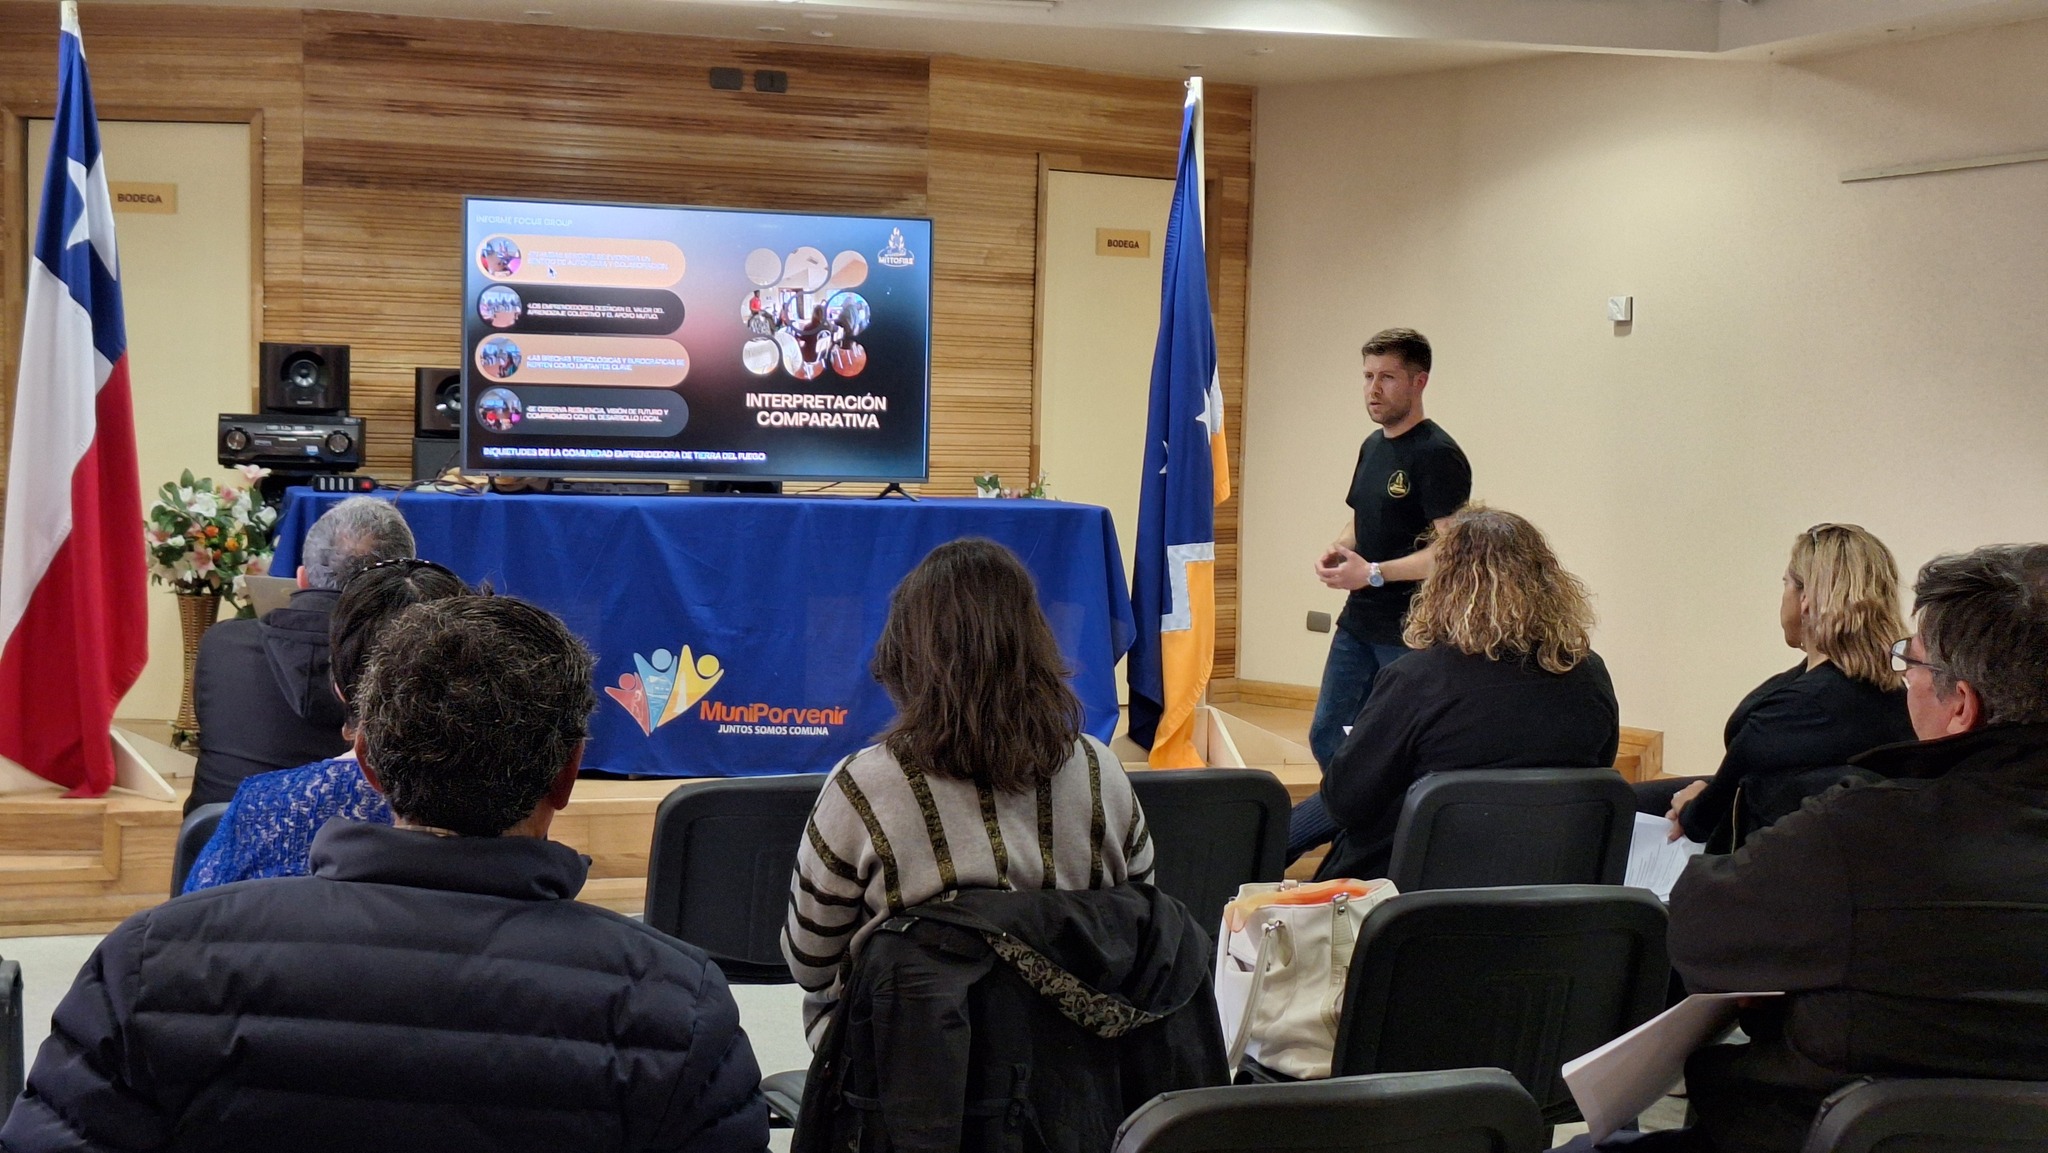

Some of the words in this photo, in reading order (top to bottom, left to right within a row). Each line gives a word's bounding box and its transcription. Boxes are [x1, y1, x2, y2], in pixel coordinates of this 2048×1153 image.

[117, 193, 163, 204] BODEGA
[544, 218, 573, 227] GROUP
[1107, 239, 1140, 249] BODEGA
[746, 392, 887, 411] INTERPRETACIÓN
[573, 413, 589, 421] CON
[756, 411, 880, 428] COMPARATIVA
[538, 448, 550, 457] DE
[551, 448, 561, 457] LA
[562, 448, 614, 458] COMUNIDAD
[614, 449, 680, 459] EMPRENDEDORA
[682, 450, 694, 460] DE
[694, 451, 721, 460] TIERRA
[722, 452, 737, 461] DEL
[738, 452, 767, 461] FUEGO
[700, 700, 848, 725] MuniPorvenir
[718, 724, 753, 735] JUNTOS
[754, 725, 788, 735] SOMOS
[789, 726, 829, 736] COMUNA
